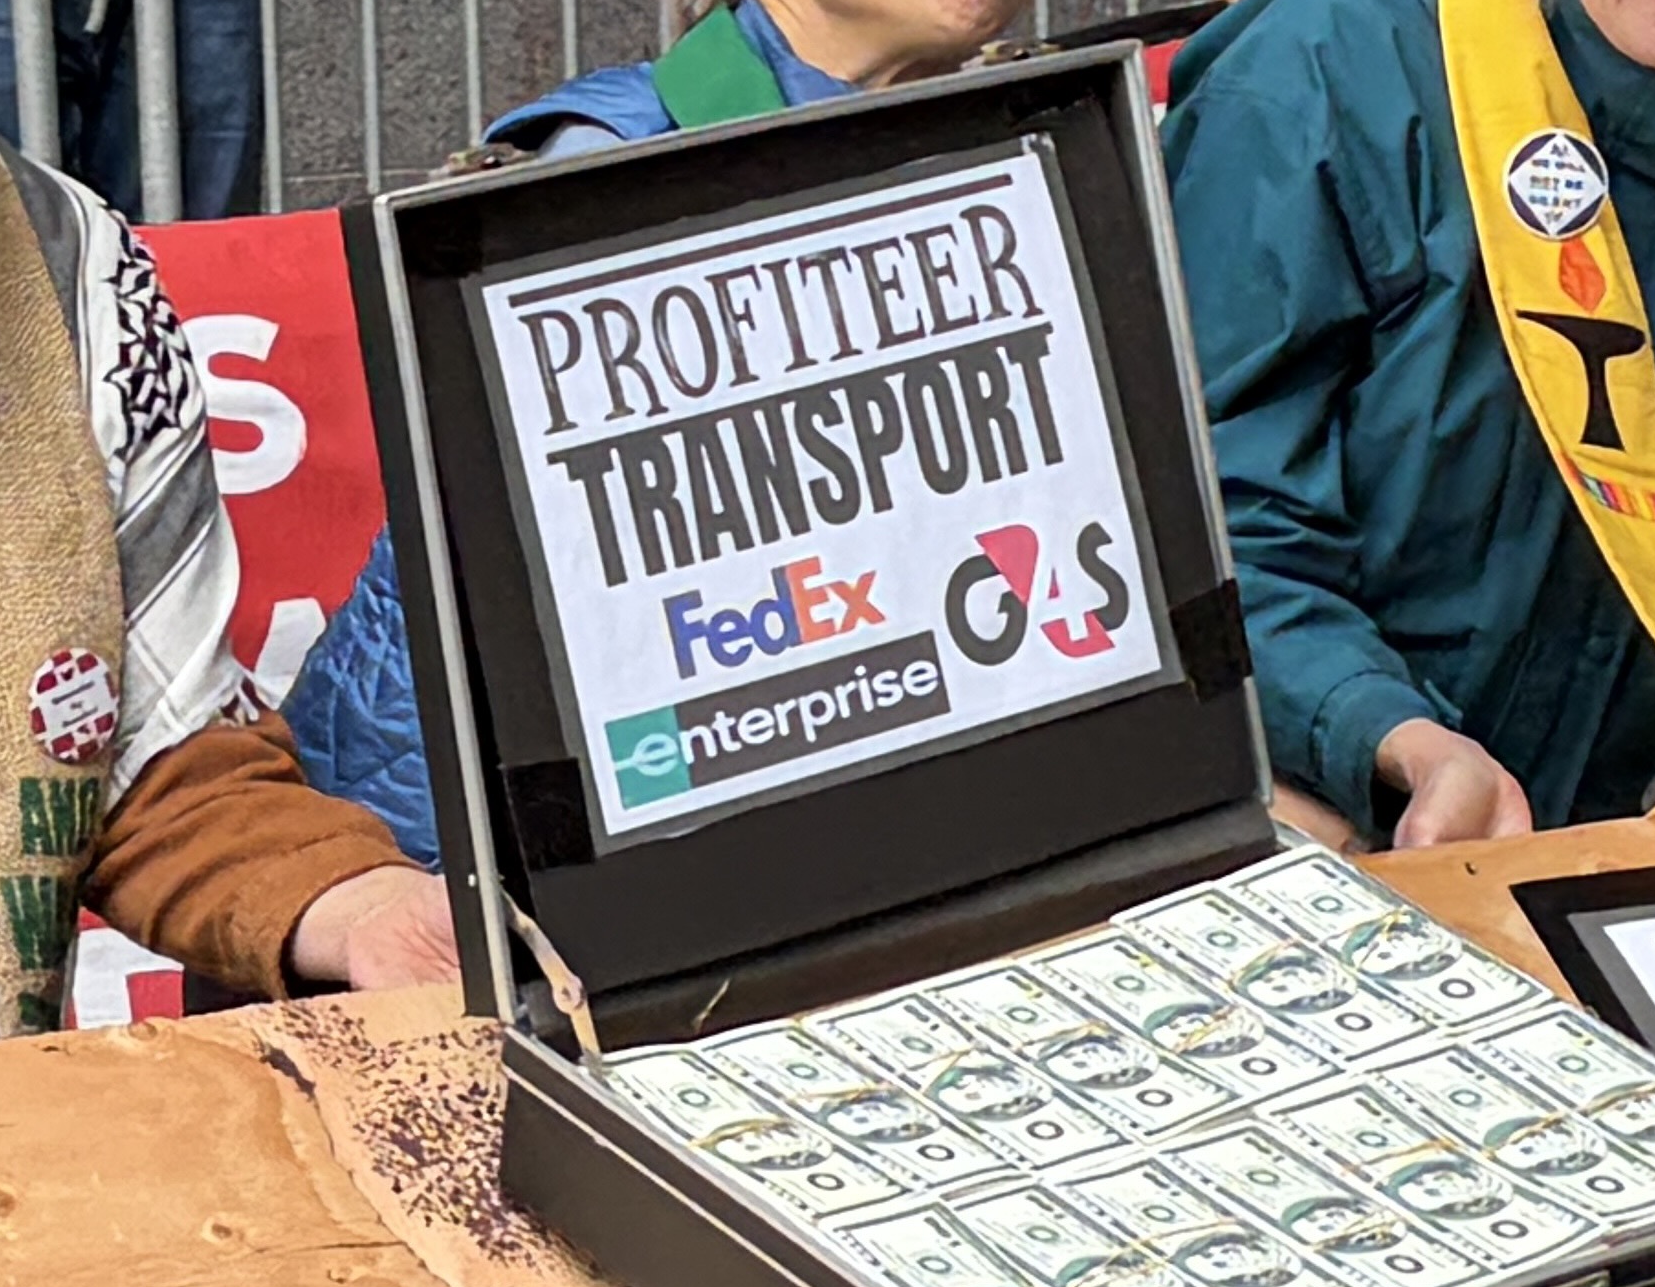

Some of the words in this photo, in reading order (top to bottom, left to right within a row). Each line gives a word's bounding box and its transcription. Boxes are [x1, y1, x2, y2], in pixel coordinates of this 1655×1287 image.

[517, 203, 1044, 437] PROFITEER
[546, 321, 1065, 588] TRANSPORT
[663, 556, 887, 680] FedEx
[945, 521, 1131, 667] G4S
[613, 654, 941, 778] enterprise
